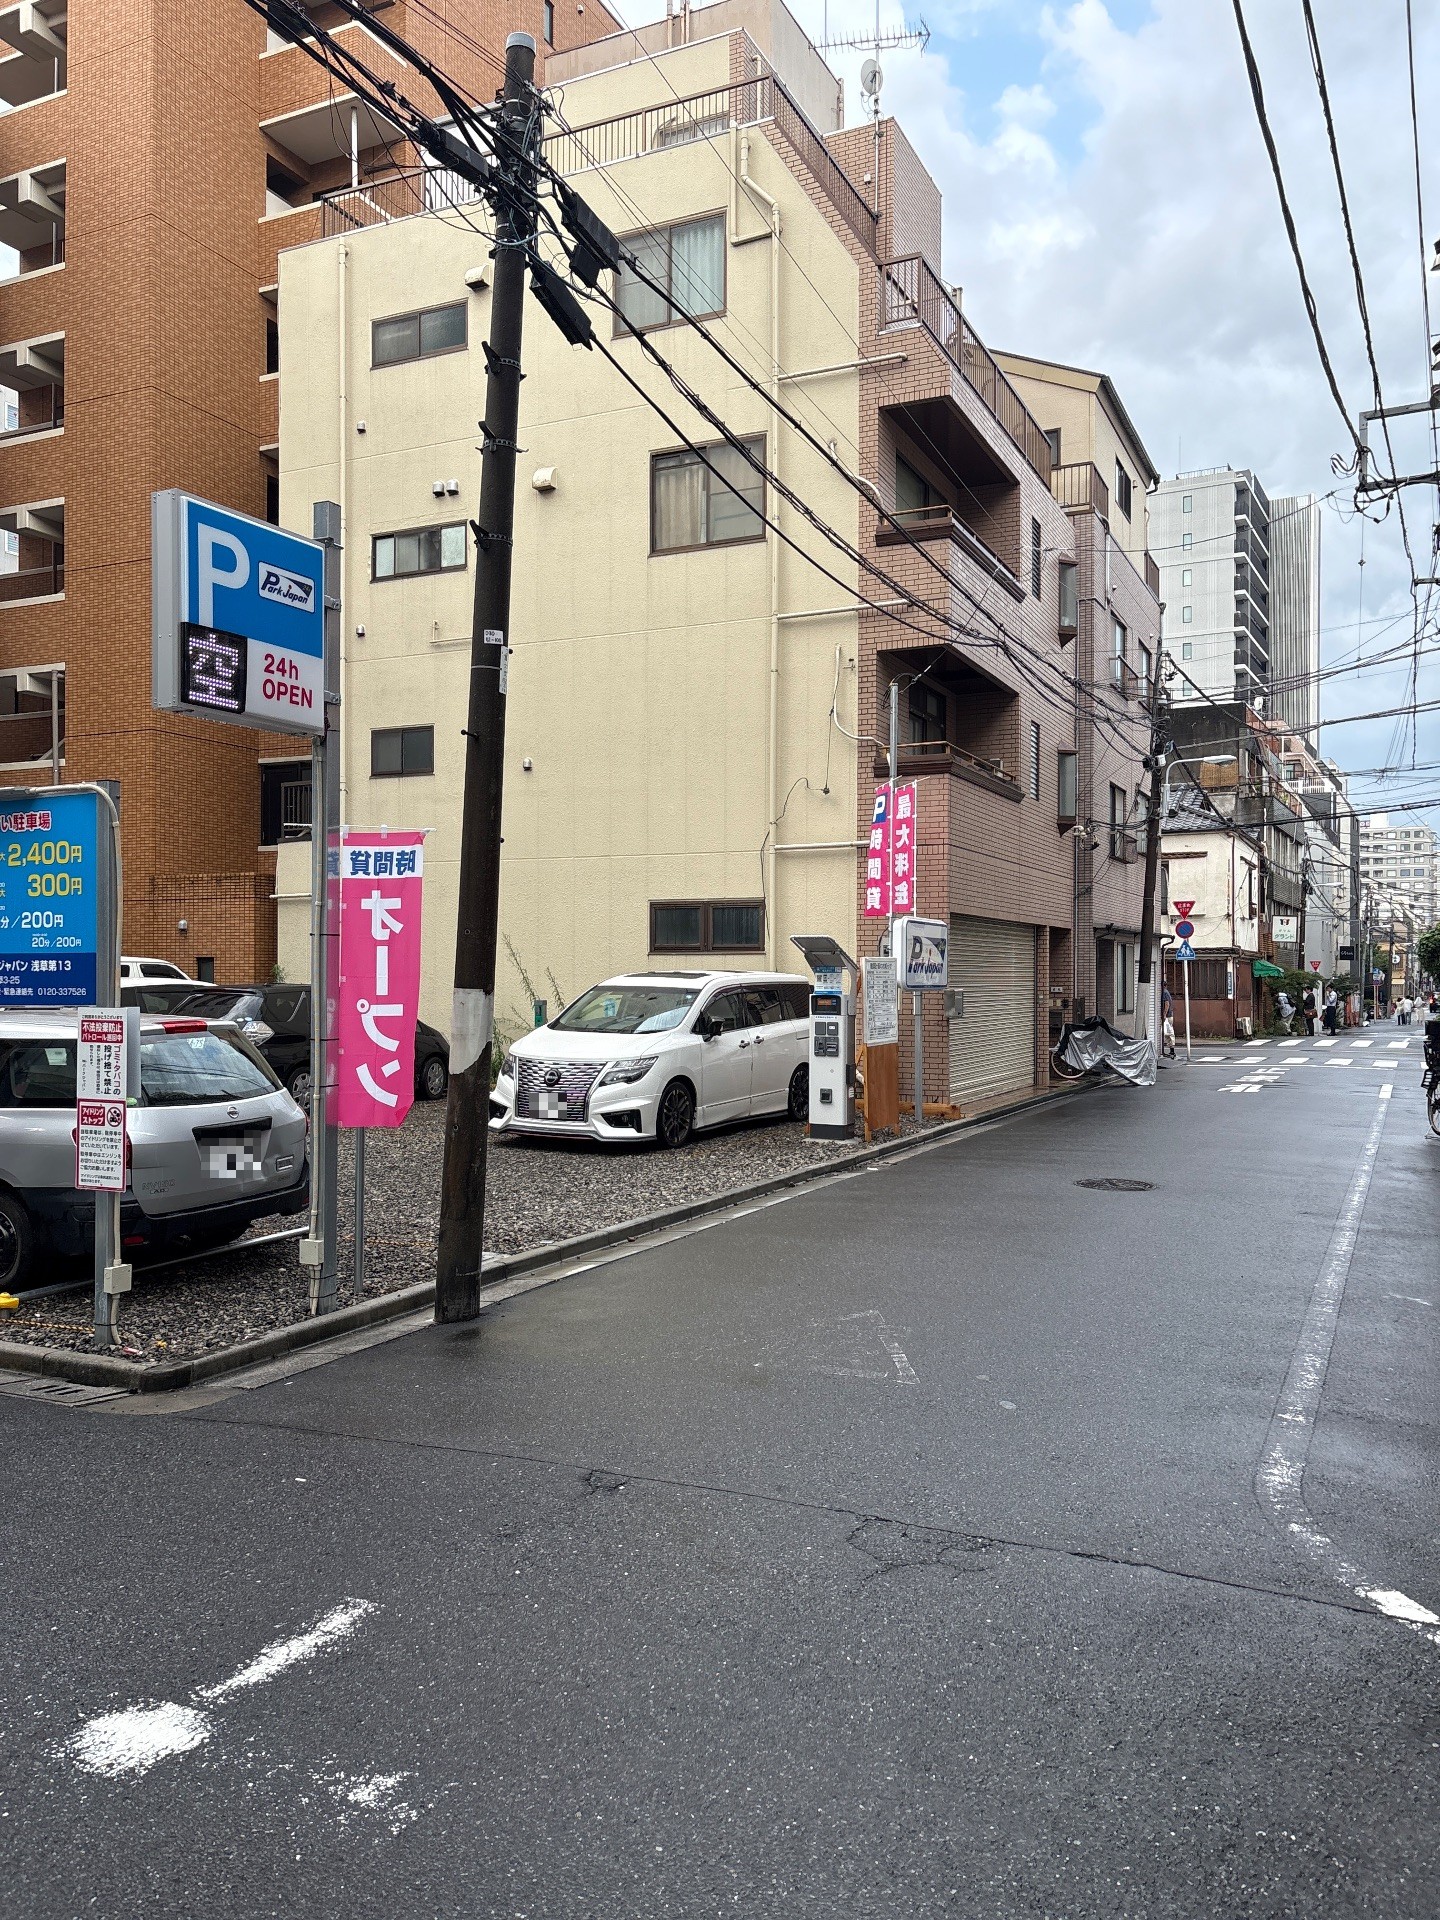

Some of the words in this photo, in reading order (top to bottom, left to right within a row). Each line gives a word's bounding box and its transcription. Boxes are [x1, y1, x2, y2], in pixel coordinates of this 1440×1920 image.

[198, 522, 250, 628] P
[261, 570, 281, 595] Park
[283, 585, 308, 604] Japan
[189, 633, 238, 709] 空
[263, 653, 299, 681] 24h
[262, 679, 313, 709] OPEN
[1, 811, 51, 832] い駐車場
[873, 795, 886, 823] P
[7, 840, 82, 866] 2,400円
[895, 794, 911, 905] 最大料金
[867, 828, 882, 910] 時間貸
[27, 873, 82, 897] 300円
[31, 960, 72, 972] 浅草第13
[37, 987, 87, 997] 0120-337526
[82, 1021, 122, 1034] 不法投棄防止
[82, 1033, 123, 1042] パトロール巡回中
[104, 1044, 112, 1095] 投げ捨て禁止
[113, 1045, 122, 1095] ゴミ・タバコの
[82, 1107, 104, 1116] アイドリング
[82, 1117, 104, 1125] ストップ
